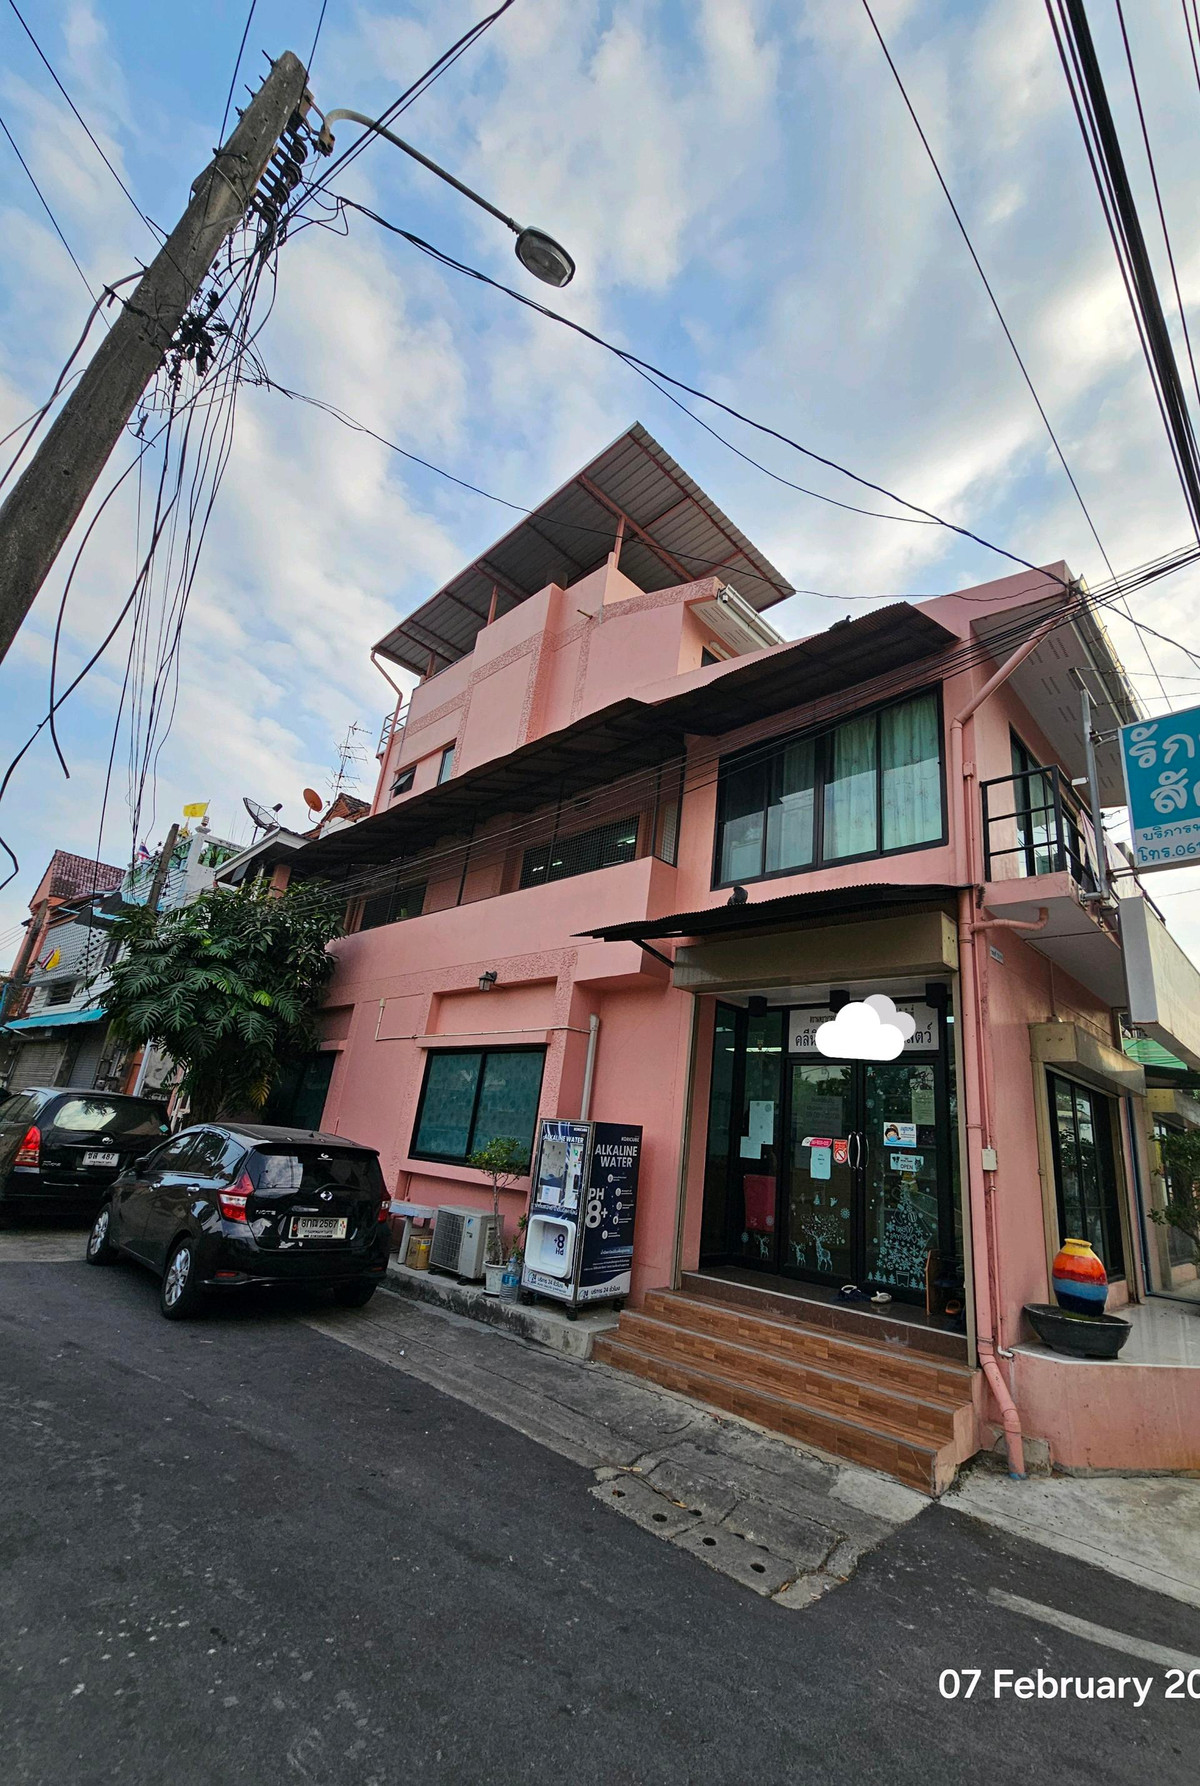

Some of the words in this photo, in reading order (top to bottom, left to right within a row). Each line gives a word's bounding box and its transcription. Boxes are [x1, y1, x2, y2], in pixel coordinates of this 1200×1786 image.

[1129, 724, 1200, 768] รัก
[1150, 768, 1200, 814] สั
[566, 1136, 584, 1144] WATER
[595, 1144, 638, 1156] ALKALINE
[600, 1156, 633, 1168] WATER
[588, 1188, 605, 1200] PH
